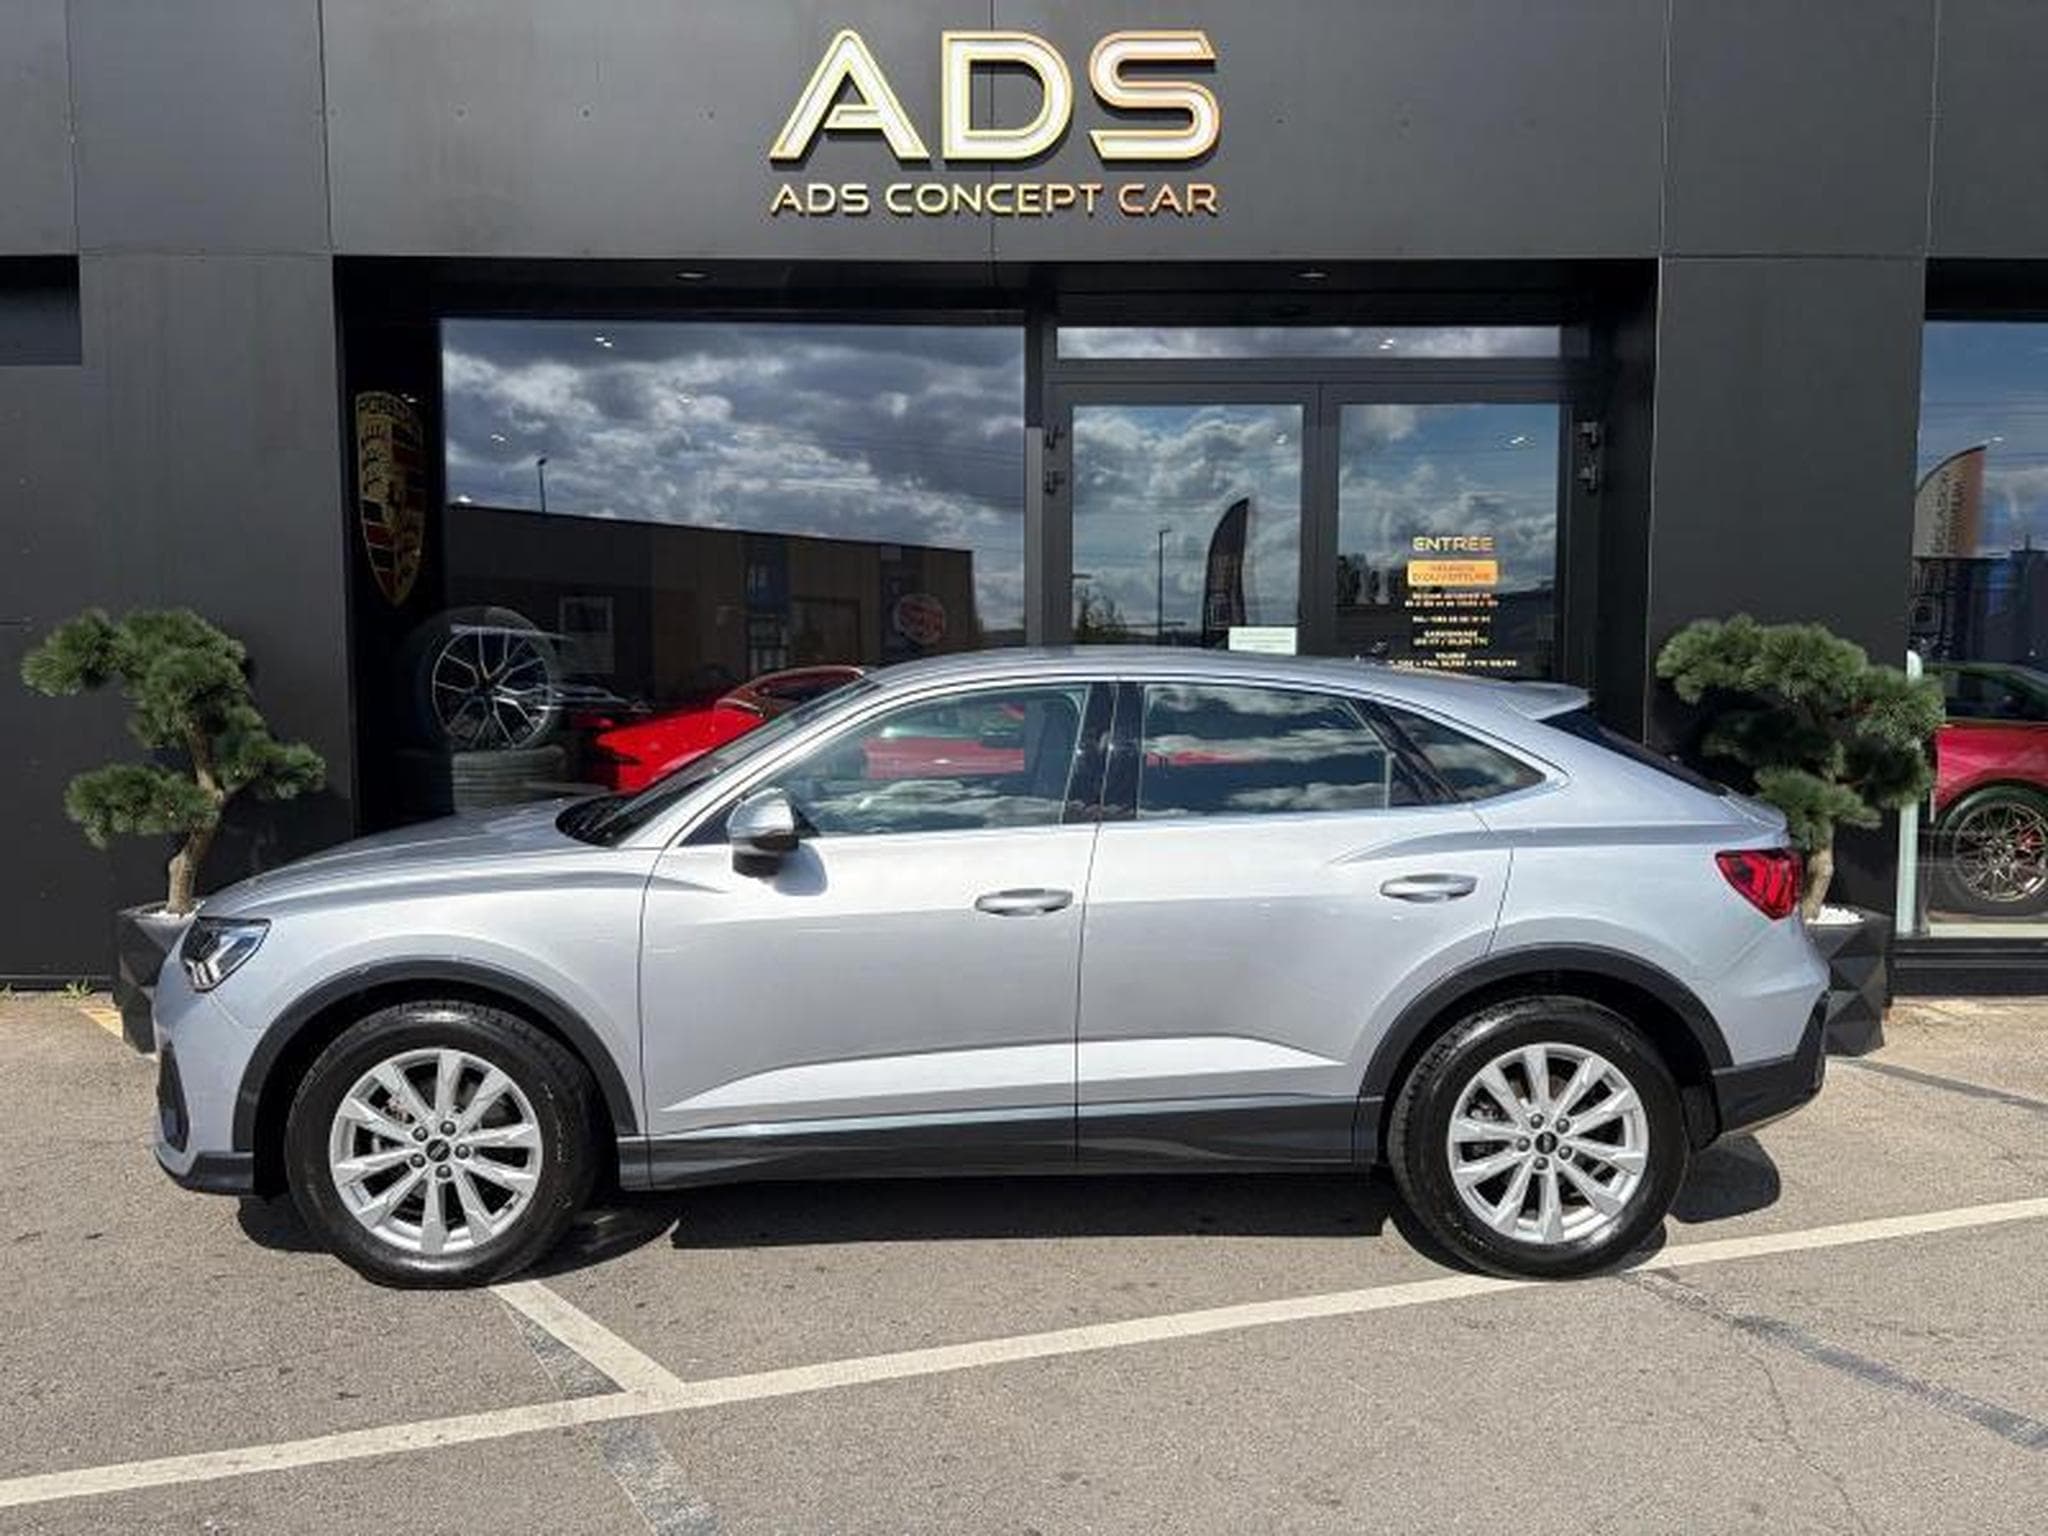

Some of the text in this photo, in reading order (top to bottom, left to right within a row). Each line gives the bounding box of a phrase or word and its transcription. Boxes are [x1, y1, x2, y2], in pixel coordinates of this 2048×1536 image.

[769, 29, 1221, 162] ADS
[771, 183, 1218, 214] ADS CONCEPT CAR
